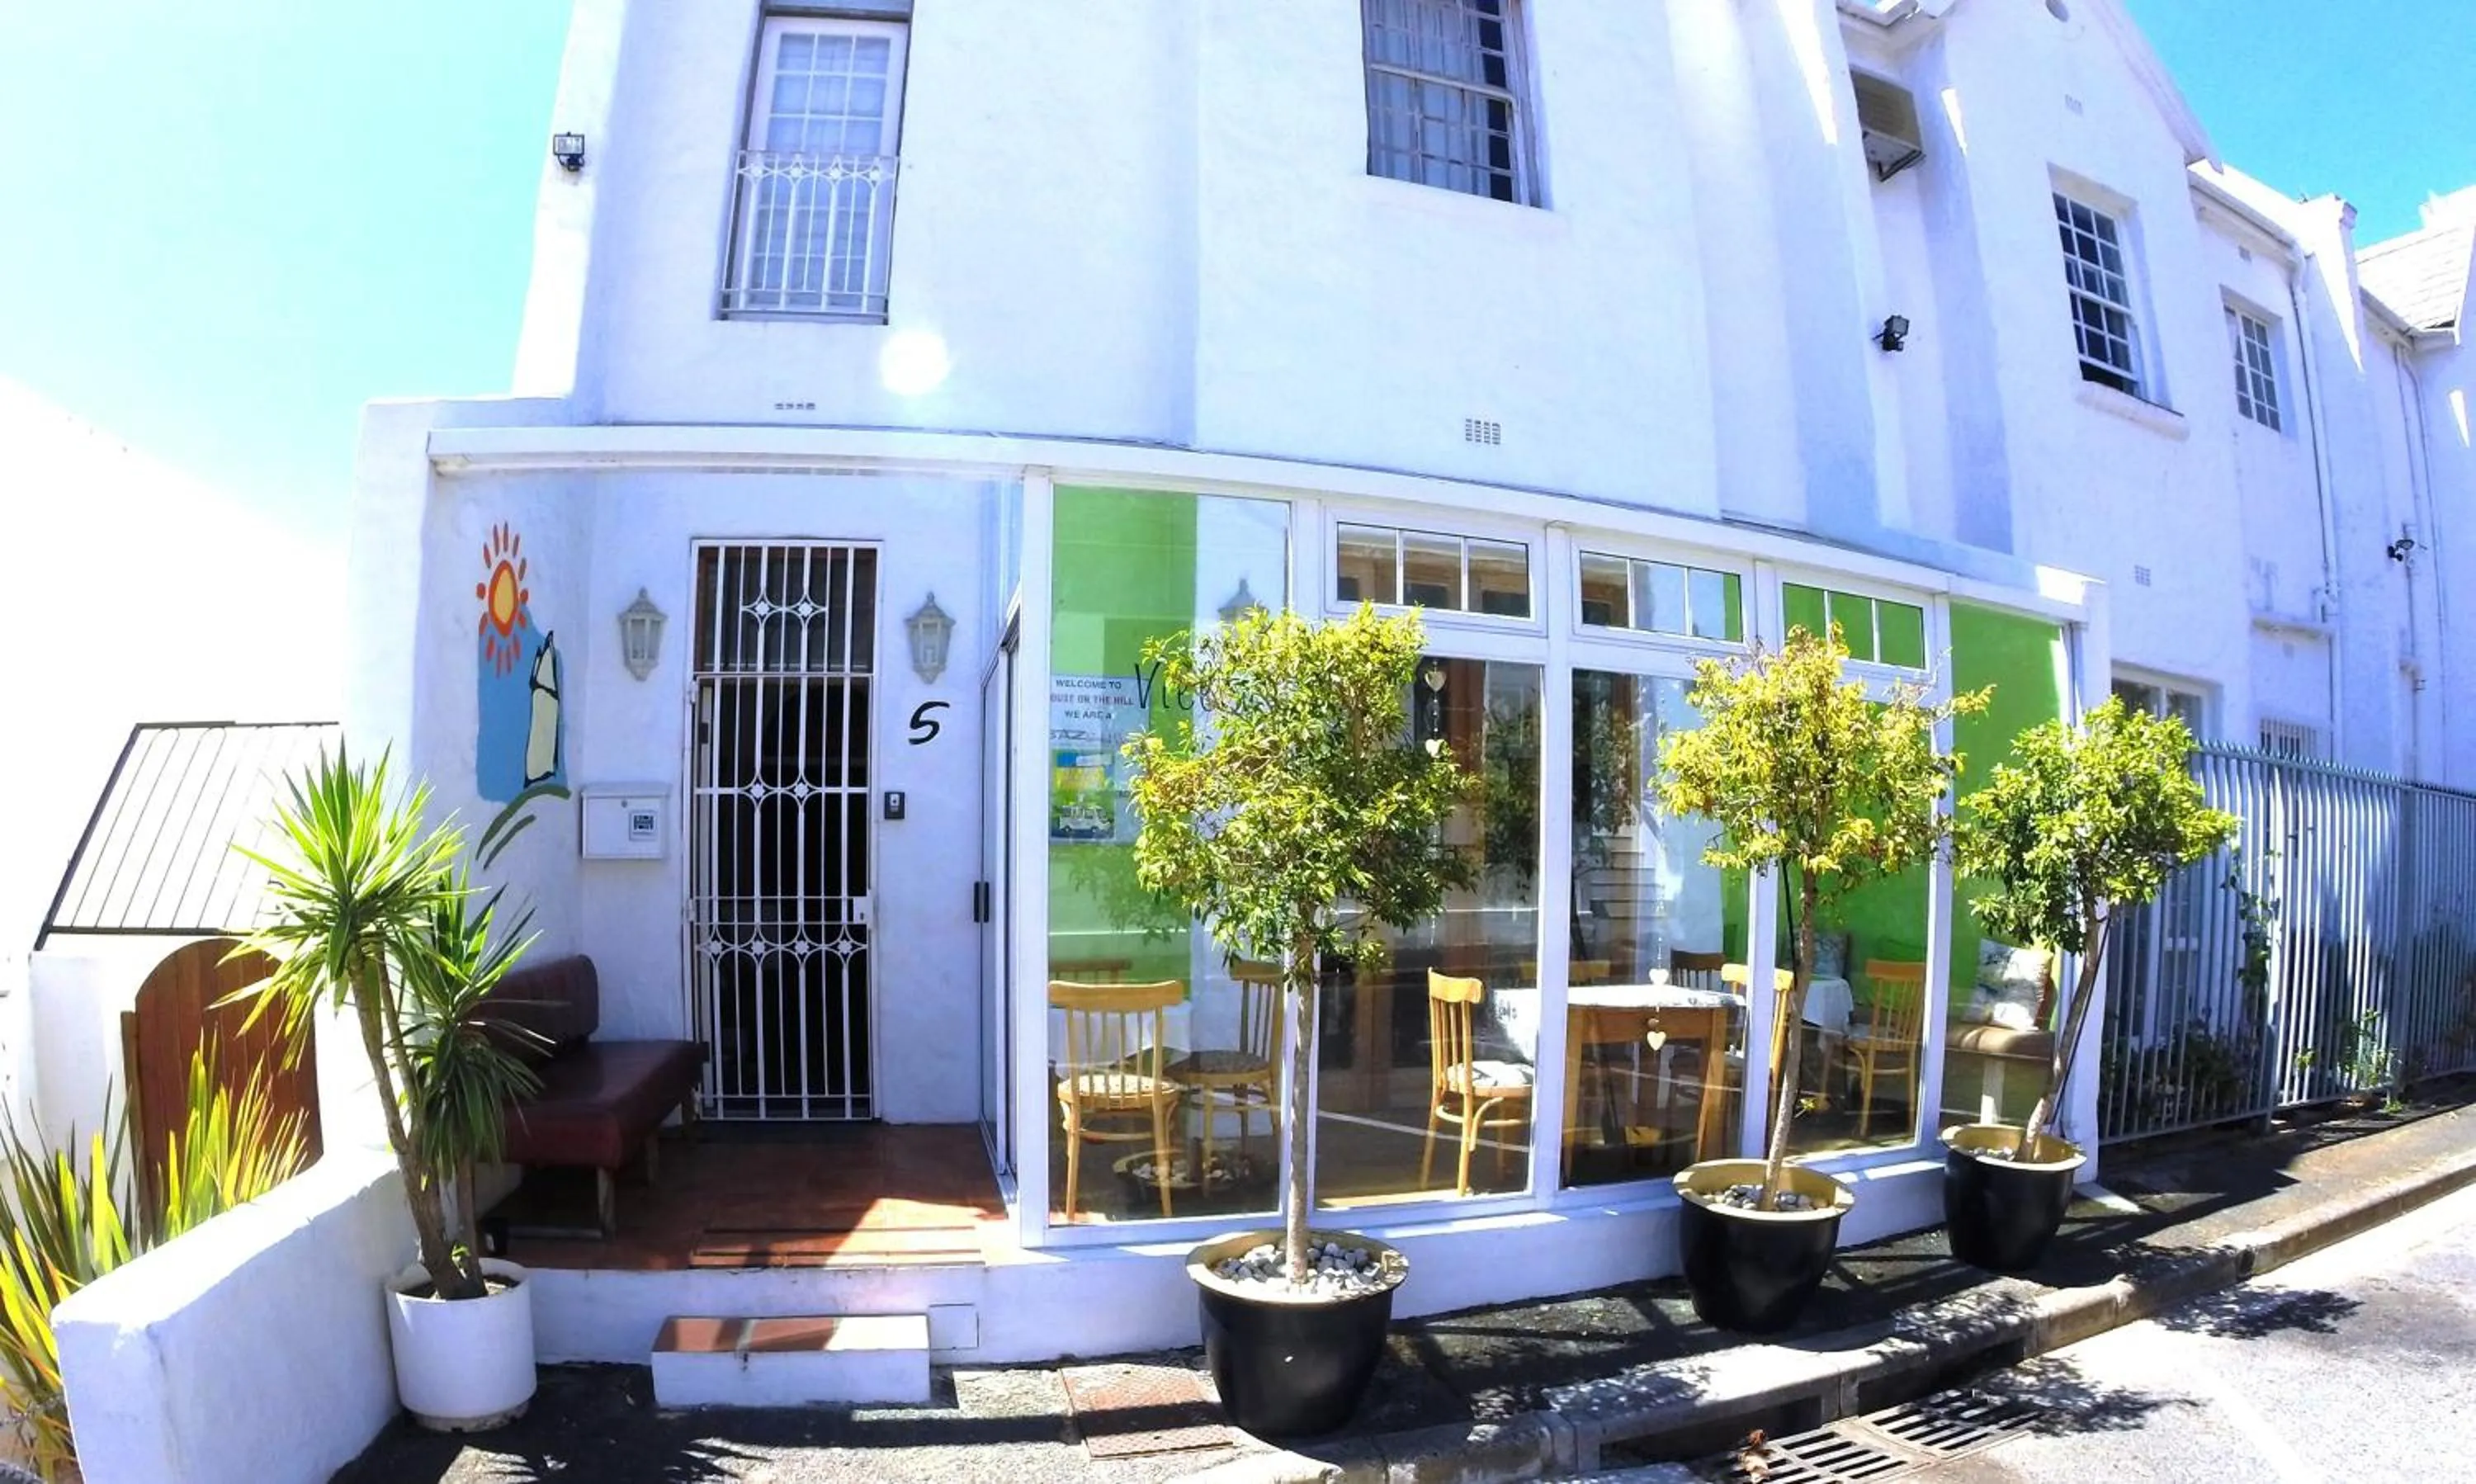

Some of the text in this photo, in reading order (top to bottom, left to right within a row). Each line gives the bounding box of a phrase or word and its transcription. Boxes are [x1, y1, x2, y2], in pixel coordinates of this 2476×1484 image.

[1056, 679, 1122, 690] WELCOME TO
[1094, 695, 1113, 705] THE
[1113, 696, 1135, 706] HILL
[1064, 710, 1080, 719] WE
[1082, 711, 1103, 720] ARE
[909, 702, 950, 744] 5
